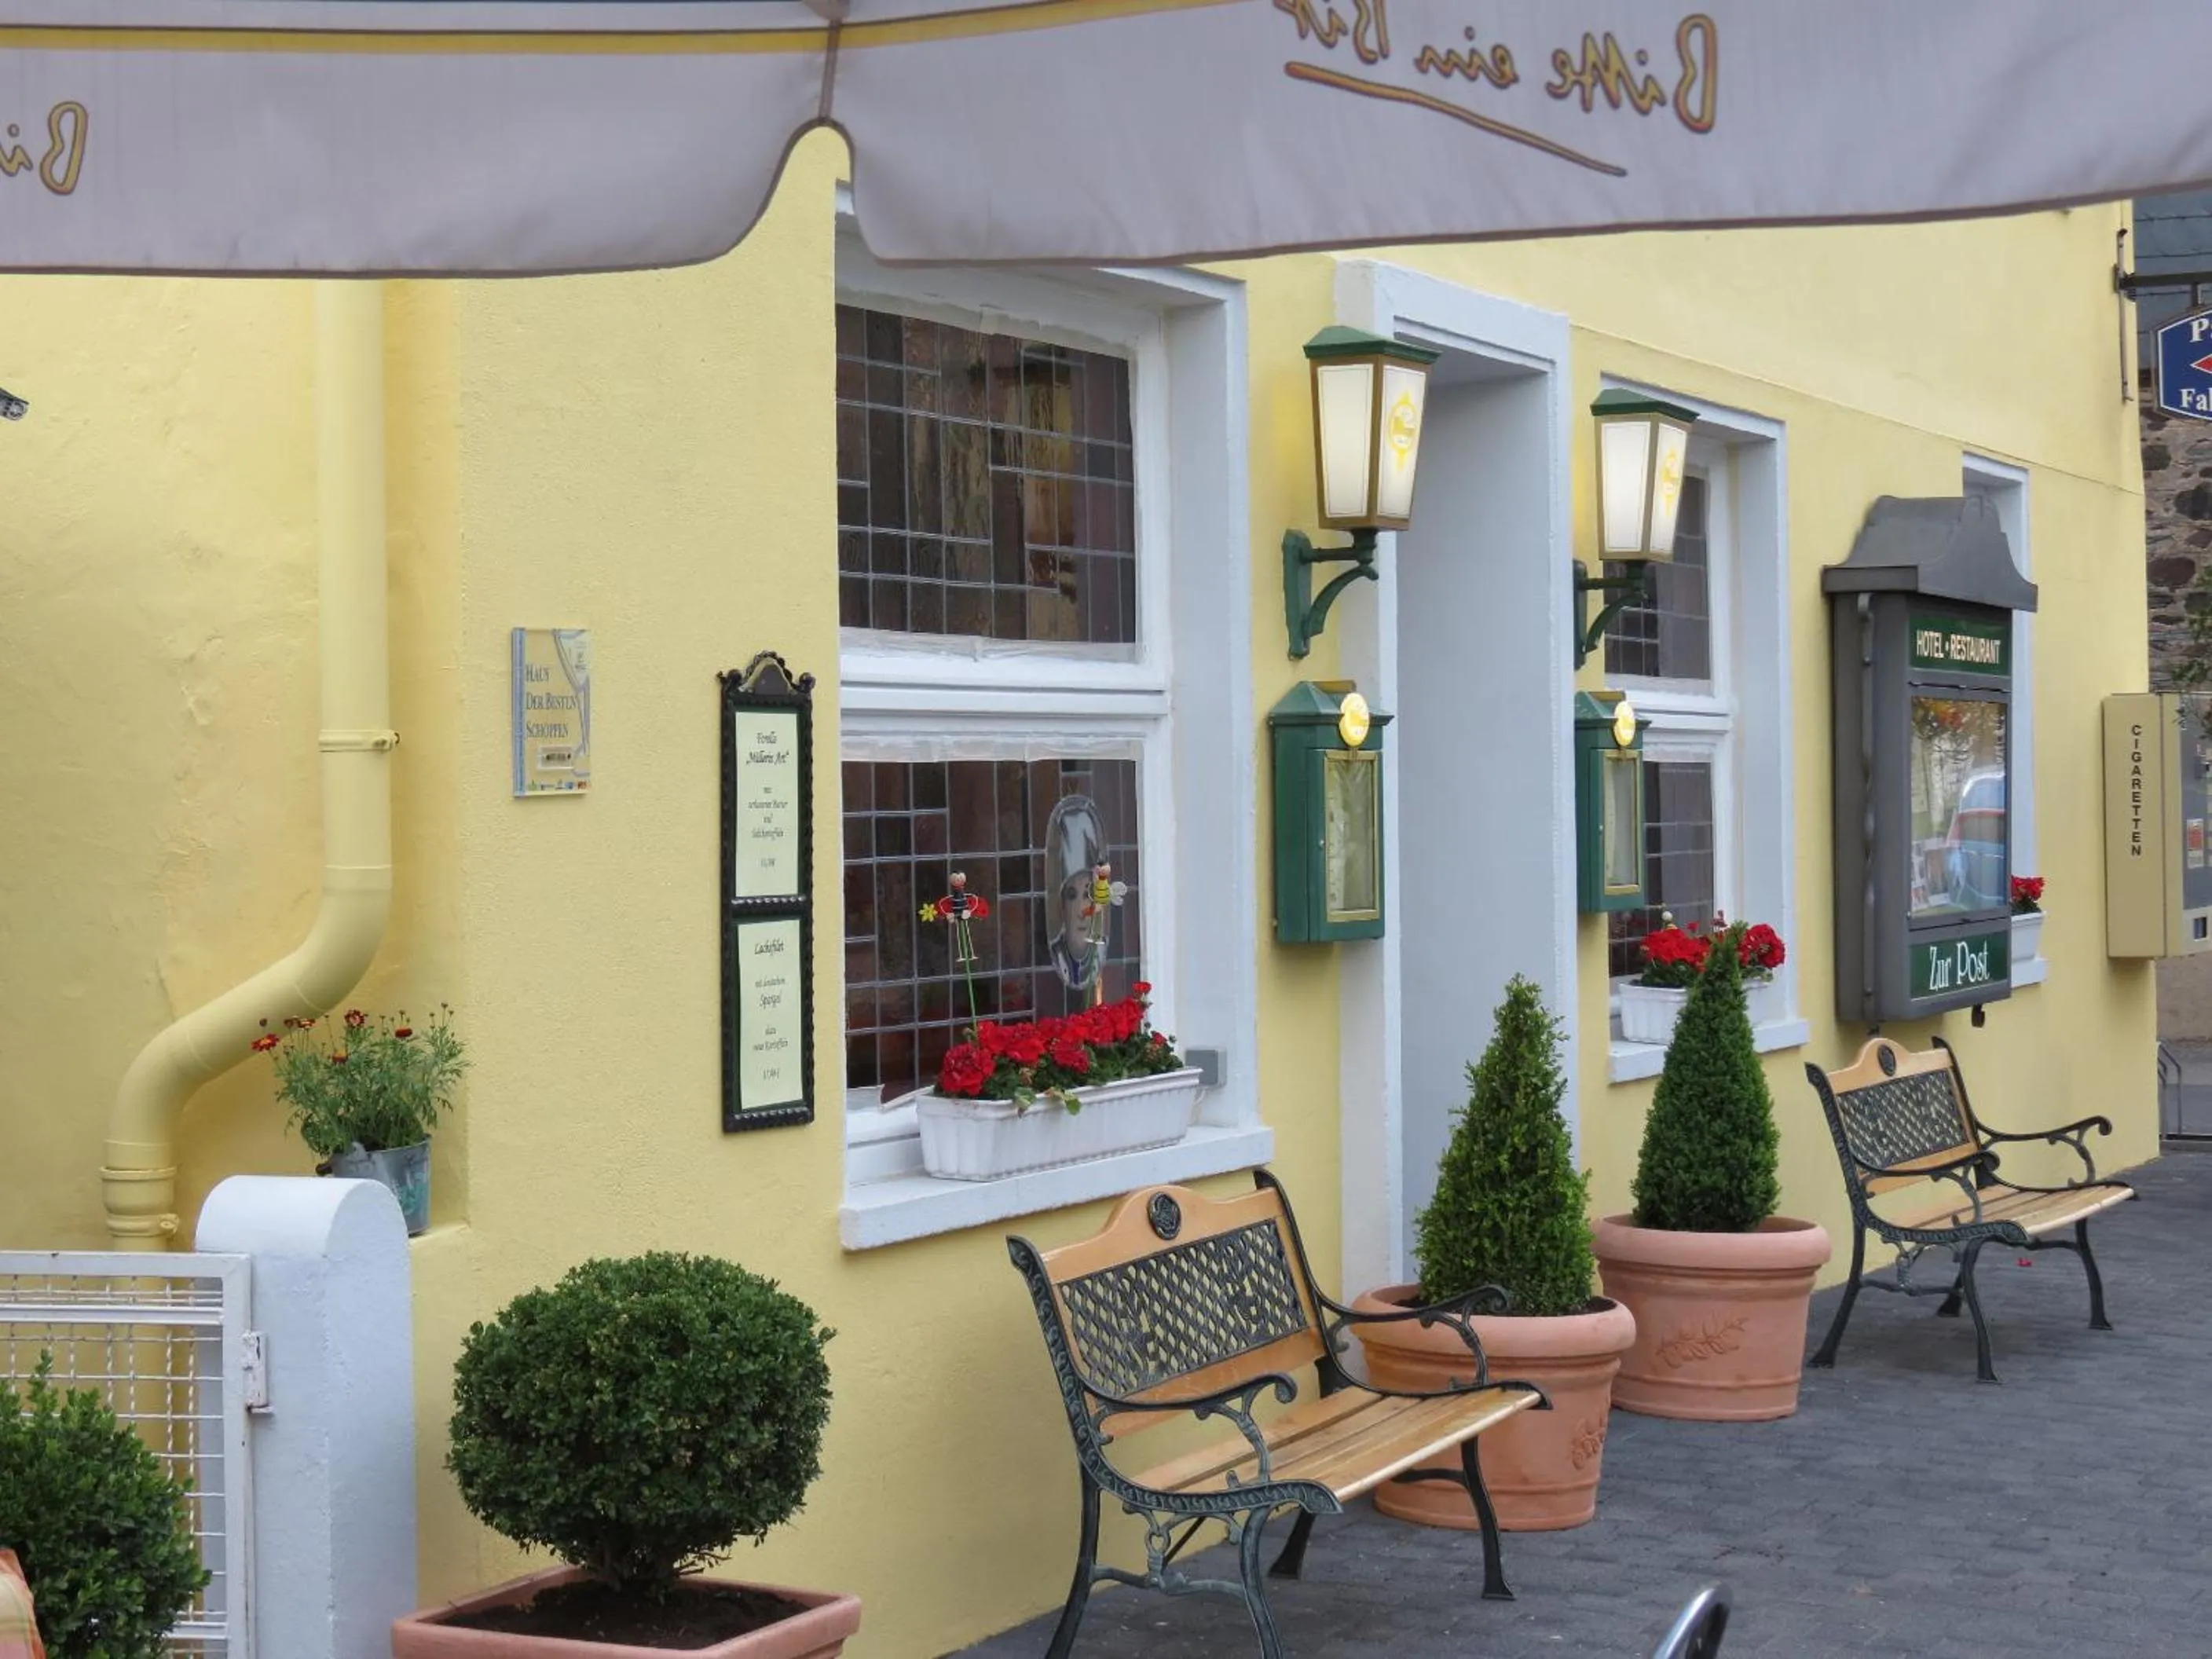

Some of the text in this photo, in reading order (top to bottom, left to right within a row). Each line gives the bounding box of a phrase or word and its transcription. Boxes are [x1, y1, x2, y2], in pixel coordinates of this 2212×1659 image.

[2189, 317, 2212, 343] P
[1916, 629, 2001, 665] HOTEL RESTAURANT
[2130, 723, 2143, 857] CIGARETTEN
[1929, 939, 1990, 991] Zur Post
